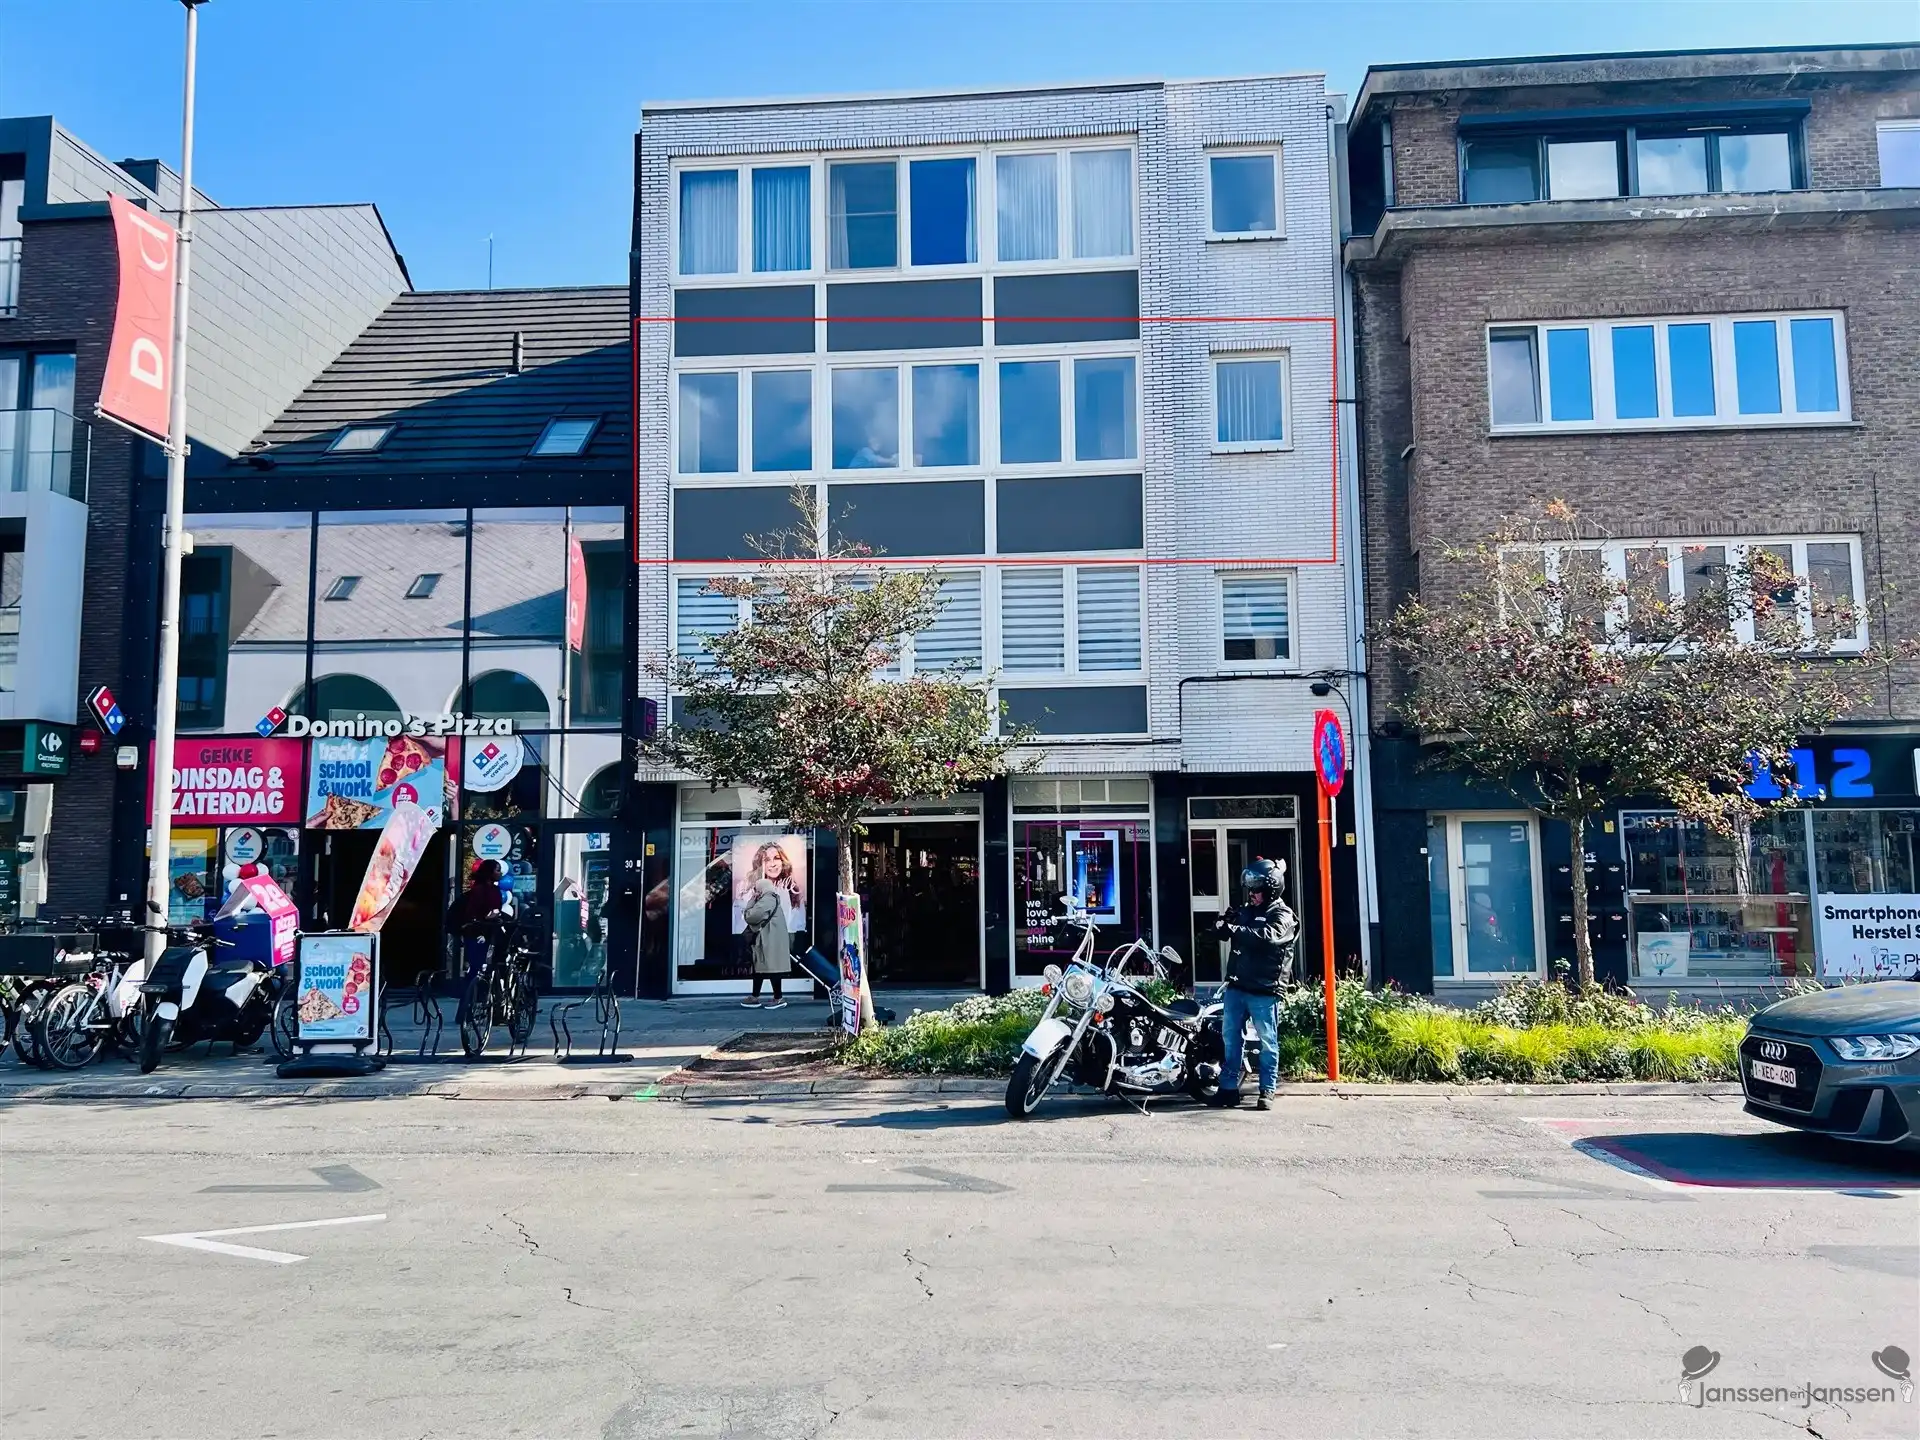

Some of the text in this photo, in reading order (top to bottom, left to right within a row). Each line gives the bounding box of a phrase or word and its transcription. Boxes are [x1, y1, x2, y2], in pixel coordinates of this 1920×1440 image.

[288, 711, 513, 737] Domino's Pizza
[37, 753, 64, 763] Carrefour
[200, 748, 253, 764] GEKKE
[319, 761, 372, 778] school
[490, 760, 509, 778] craving
[171, 766, 285, 790] DINSDAG &
[318, 779, 372, 797] & work
[625, 860, 633, 868] 30
[1026, 899, 1041, 908] we
[1026, 908, 1048, 917] love
[1824, 905, 1920, 923] Smartphon
[1026, 918, 1058, 927] to see
[1027, 934, 1054, 944] shine
[1852, 924, 1911, 940] Herstel
[304, 965, 344, 977] school
[304, 978, 344, 989] & work
[1754, 1063, 1795, 1085] 1-XEC-480
